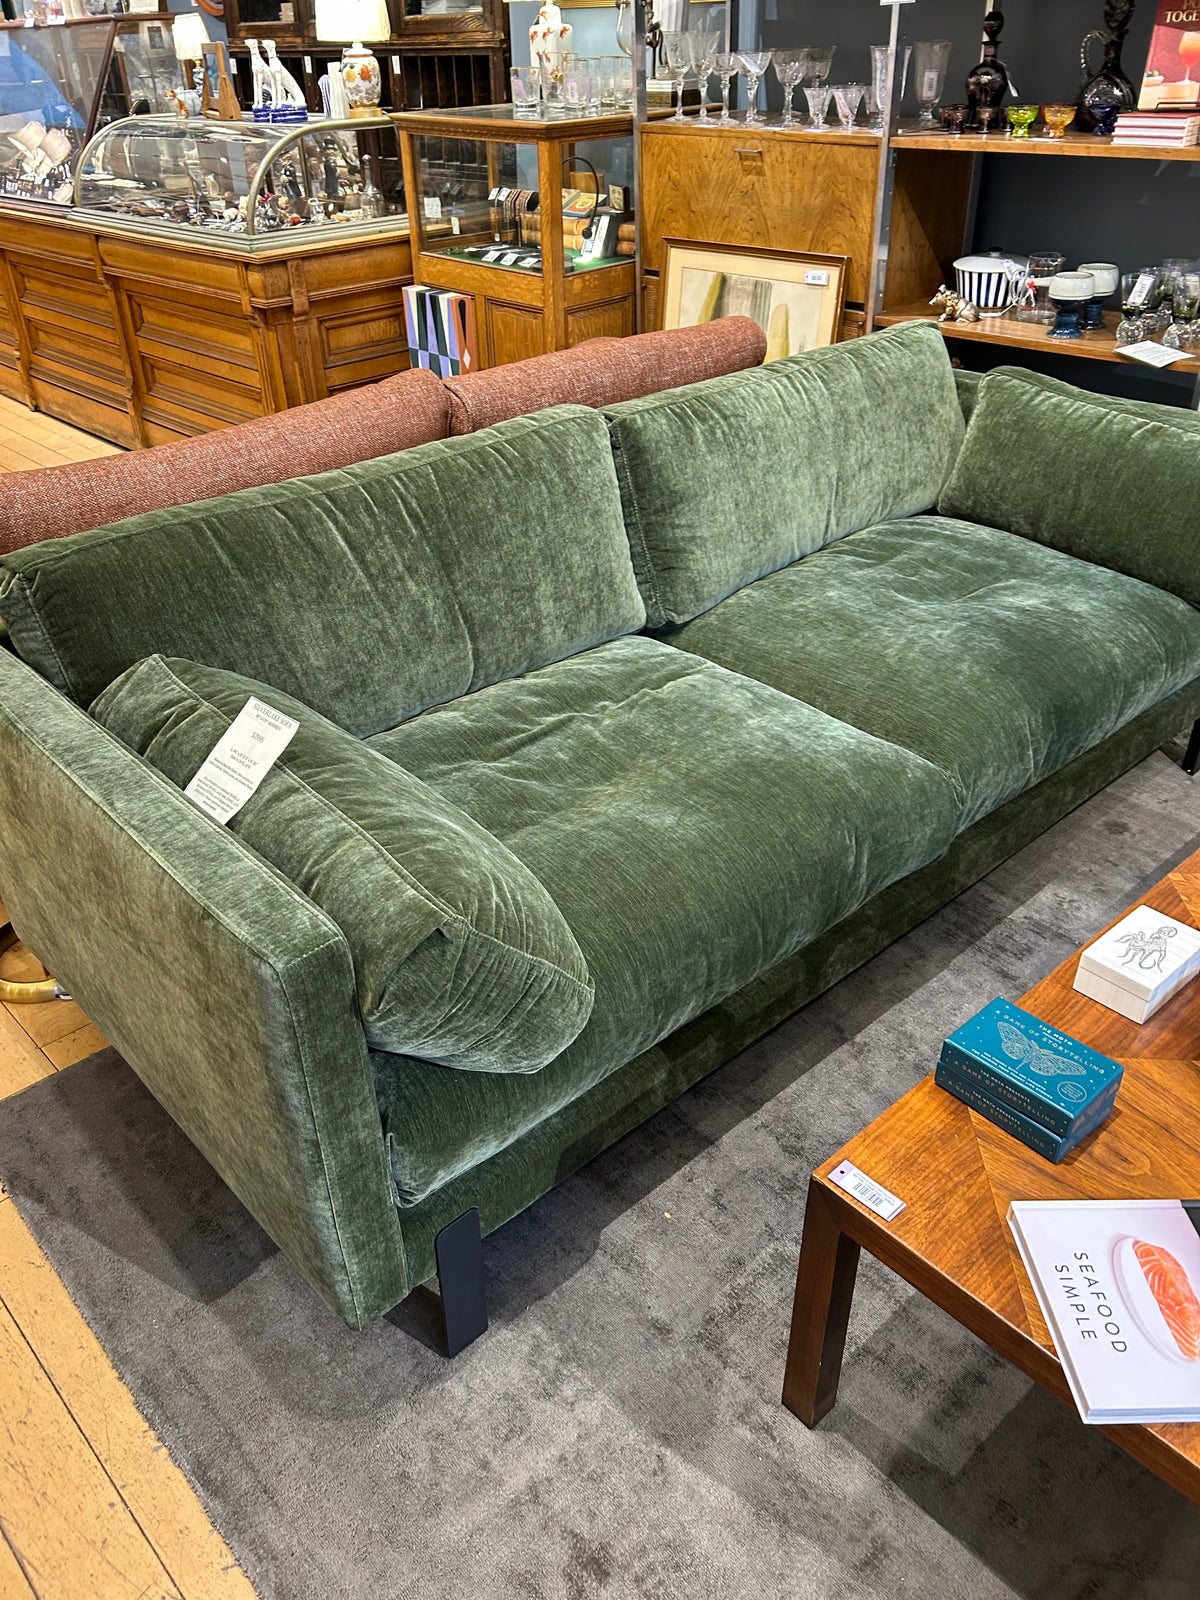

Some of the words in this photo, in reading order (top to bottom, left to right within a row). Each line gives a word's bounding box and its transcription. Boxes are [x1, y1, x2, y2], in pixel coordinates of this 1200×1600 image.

[1003, 1014, 1026, 1030] GAME
[1028, 1029, 1040, 1038] OF
[1042, 1036, 1105, 1075] STORYTELLING
[1038, 1024, 1052, 1034] THE
[1053, 1033, 1073, 1046] MOTH
[955, 1085, 975, 1101] GAME
[989, 1108, 1046, 1148] STORYTELLING
[961, 1064, 983, 1080] GAME
[984, 1079, 996, 1088] OF
[997, 1087, 1057, 1126] STORYTELLING
[1005, 1085, 1031, 1103] PRESENTS
[1055, 1264, 1098, 1340] SIMPLE
[1074, 1252, 1128, 1353] SEAFOOD
